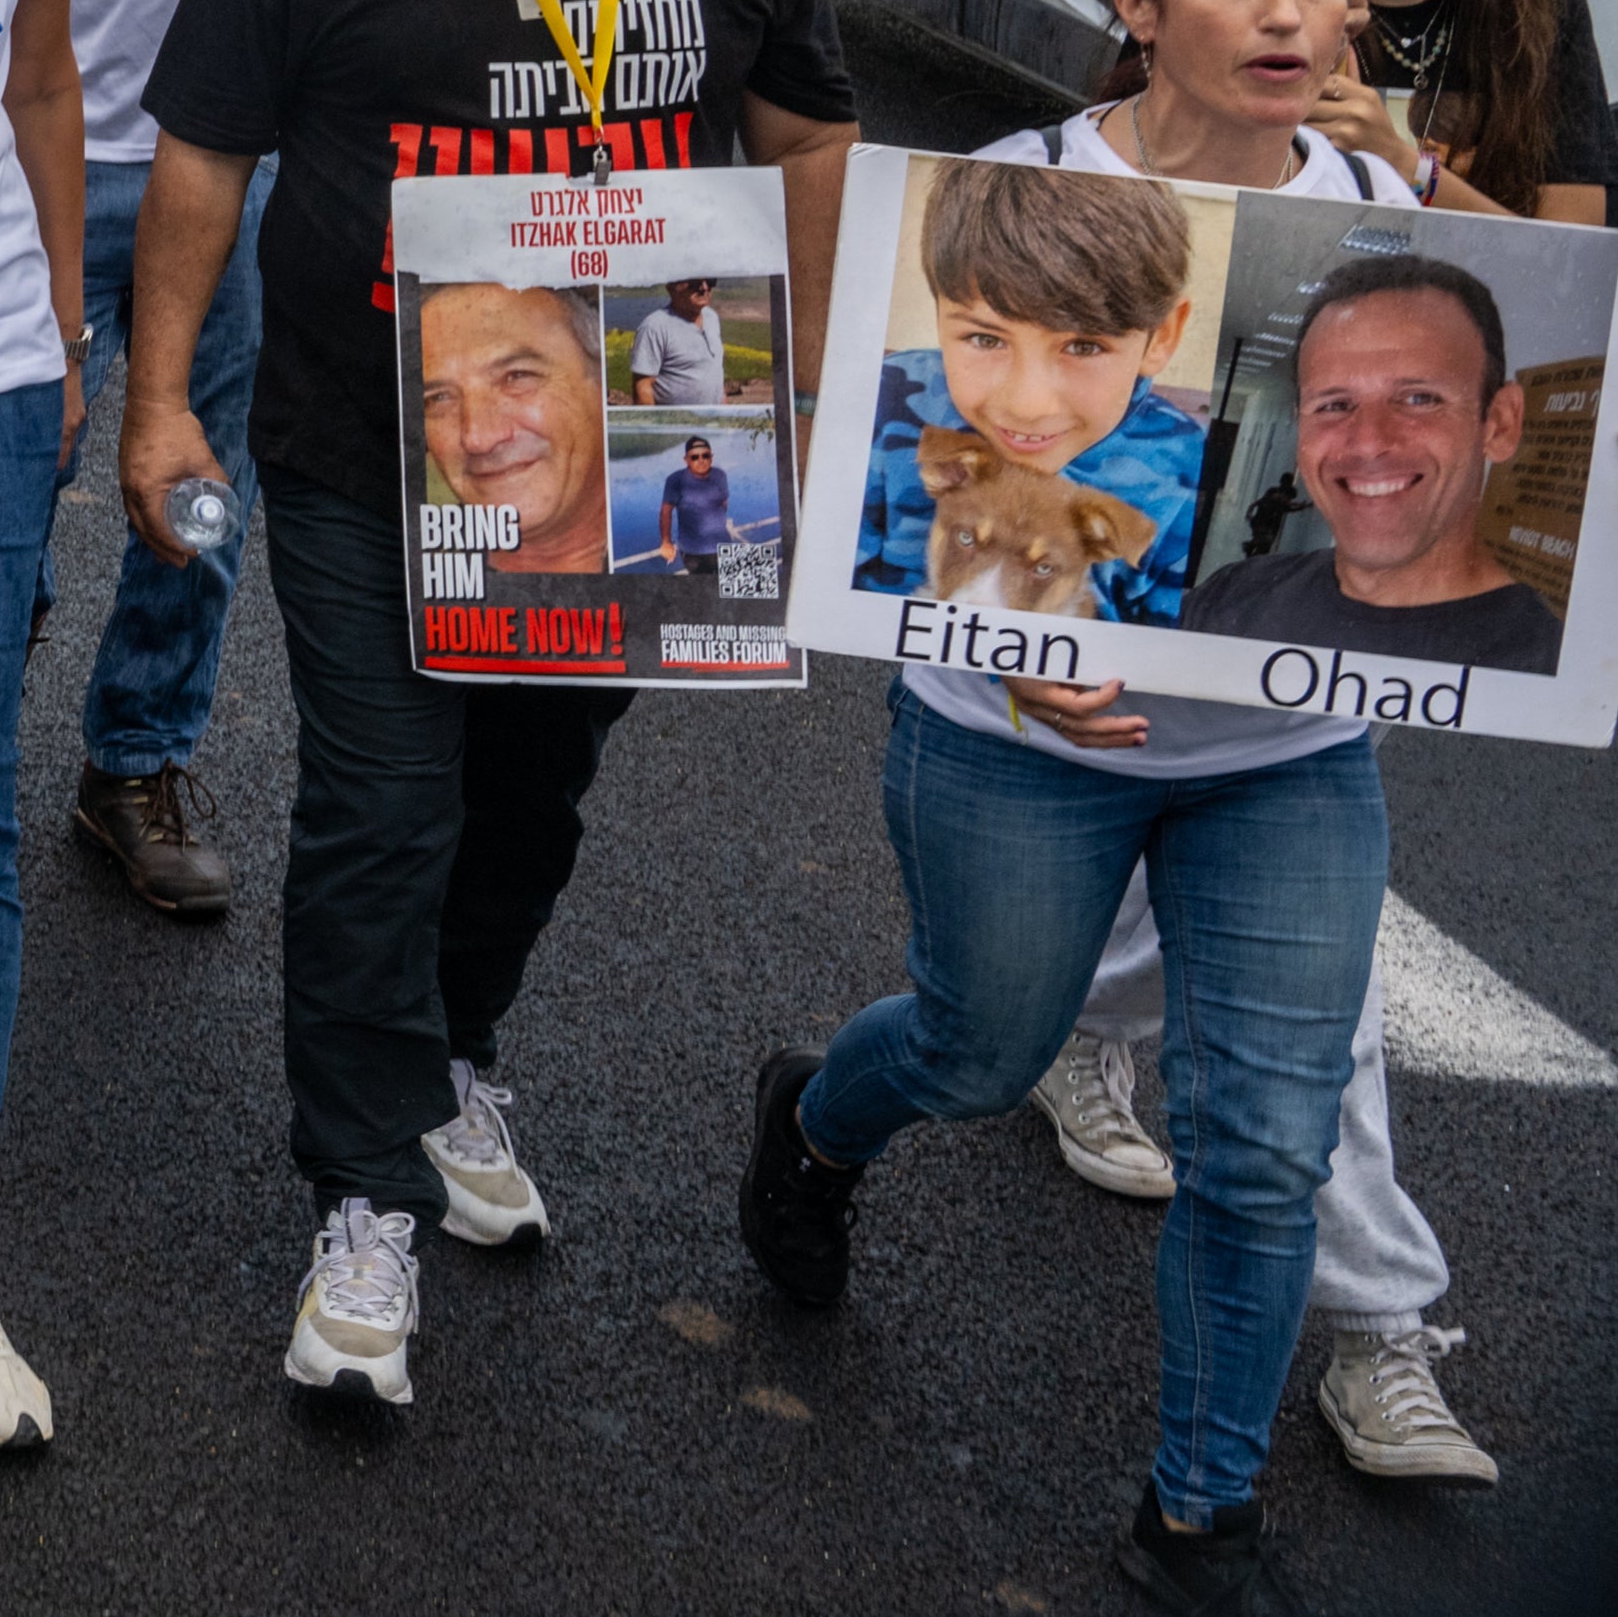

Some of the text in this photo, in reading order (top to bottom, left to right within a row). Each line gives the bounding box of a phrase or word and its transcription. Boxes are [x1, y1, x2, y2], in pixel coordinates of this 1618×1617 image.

[616, 50, 707, 109] אותם
[530, 187, 643, 218] יצחק אלגרט
[510, 217, 666, 248] ITZHAK ELGARAT
[570, 249, 609, 278] (68)
[420, 504, 520, 551] BRING
[422, 551, 486, 600] HIM
[425, 602, 625, 657] HOME NOW!
[660, 624, 786, 641] HOSTAGES AND MISSING
[661, 640, 786, 664] FAMILIES FORUM
[895, 598, 1471, 728] Eitan Ohad
